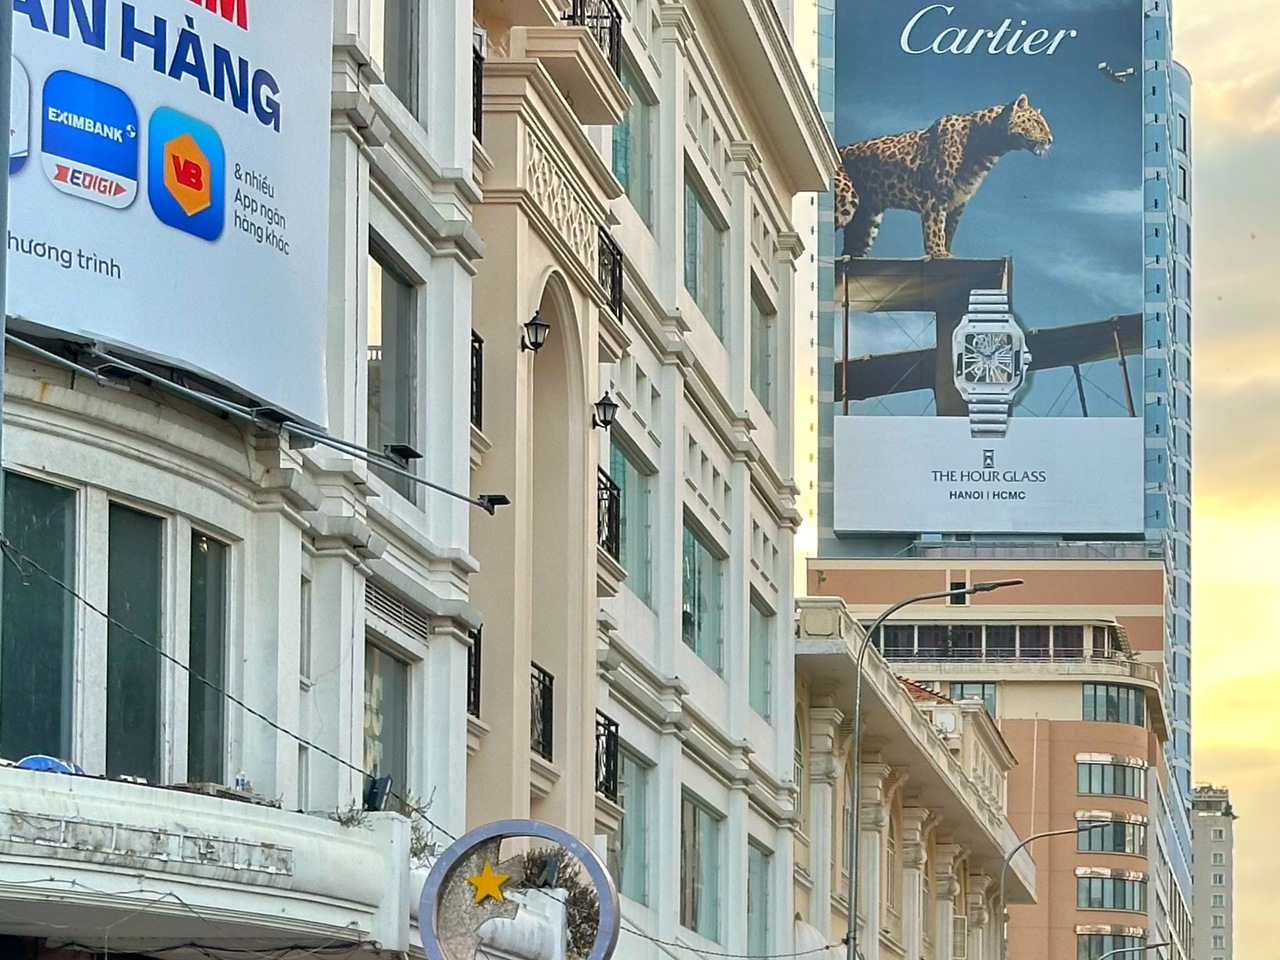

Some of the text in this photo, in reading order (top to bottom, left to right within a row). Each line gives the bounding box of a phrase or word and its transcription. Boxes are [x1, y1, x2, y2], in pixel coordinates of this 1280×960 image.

[900, 3, 1077, 55] Cartier
[121, 2, 281, 133] HÀNG
[48, 107, 123, 143] EXIMBANK
[70, 169, 115, 195] EDIGI
[172, 154, 203, 191] VB
[234, 163, 243, 181] &
[234, 187, 286, 230] App ngân
[234, 210, 290, 255] hàng khác
[77, 249, 121, 279] trình
[931, 470, 1046, 482] THE HOUR GLASS
[949, 490, 983, 500] HANOI
[992, 490, 1026, 500] HCMC
